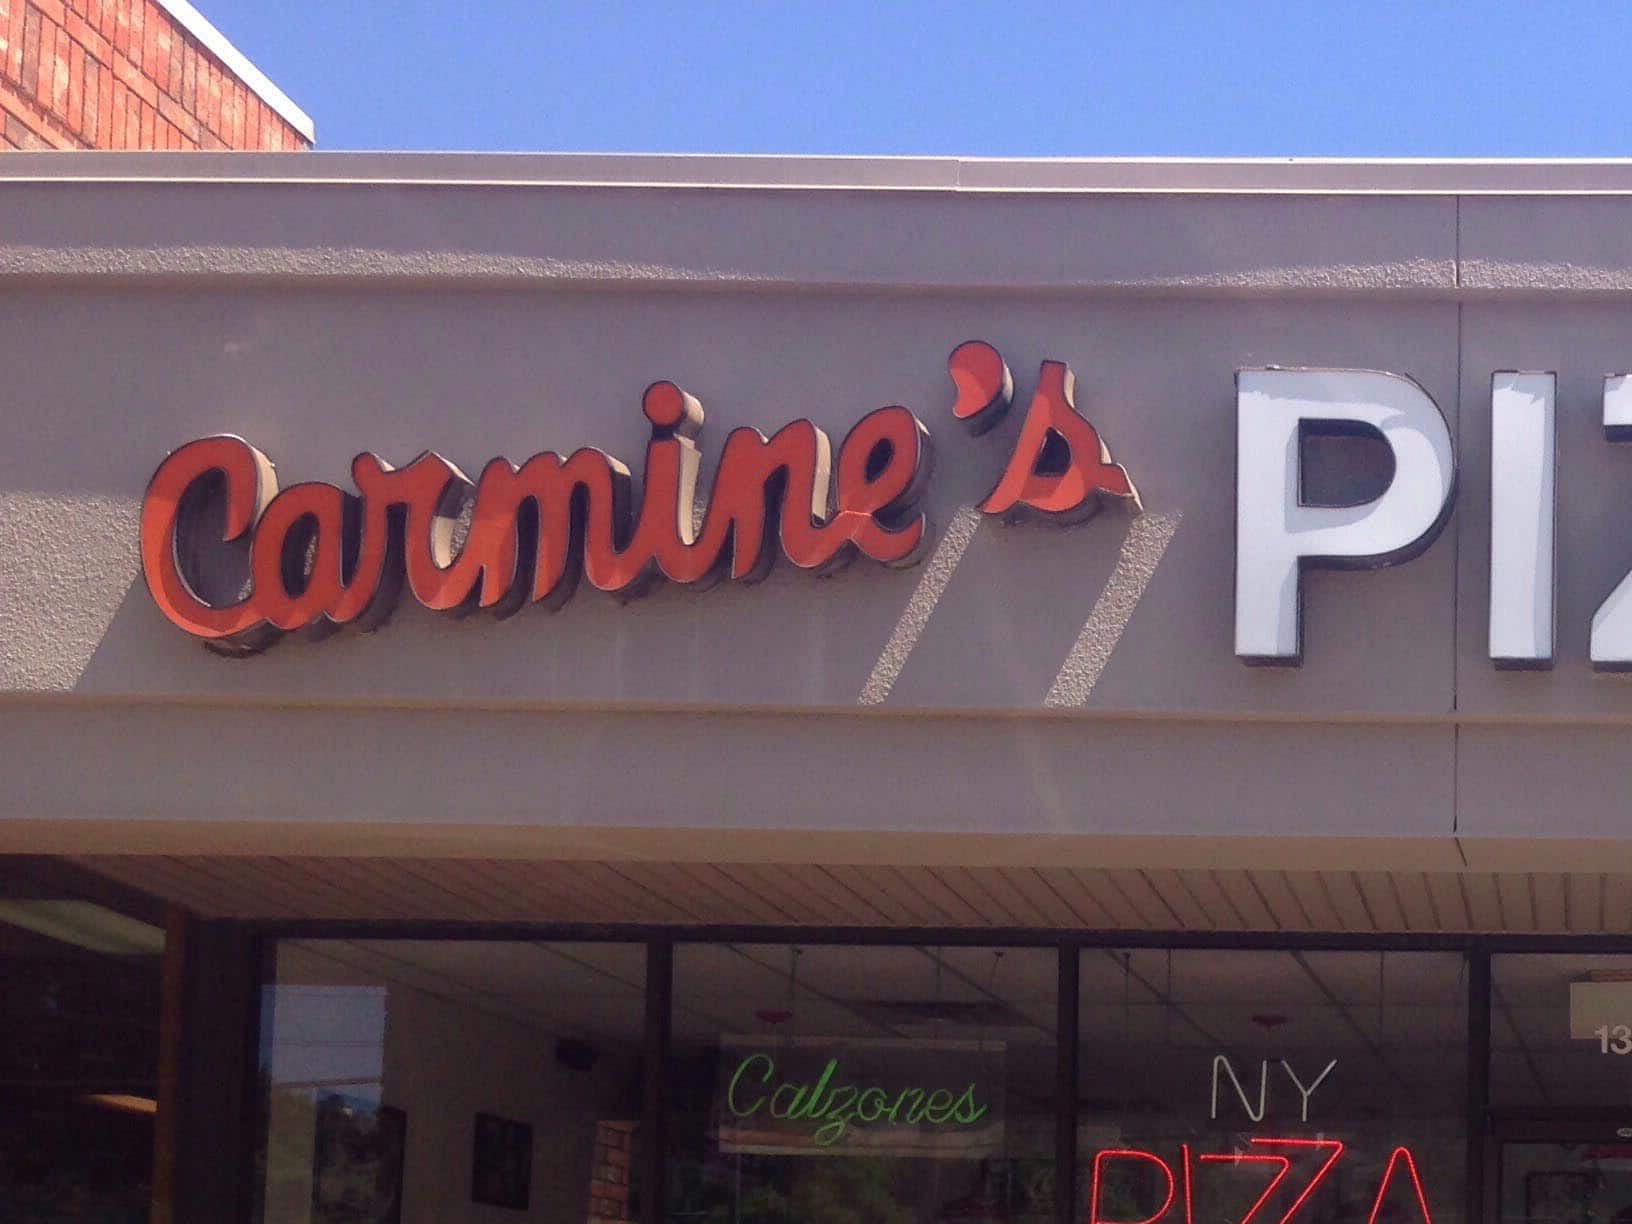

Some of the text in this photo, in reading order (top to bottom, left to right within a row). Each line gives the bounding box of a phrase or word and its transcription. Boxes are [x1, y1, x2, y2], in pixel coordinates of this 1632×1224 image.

[140, 340, 1144, 645] Carmine's
[726, 1053, 989, 1147] Calzones
[1210, 1054, 1338, 1123] NY
